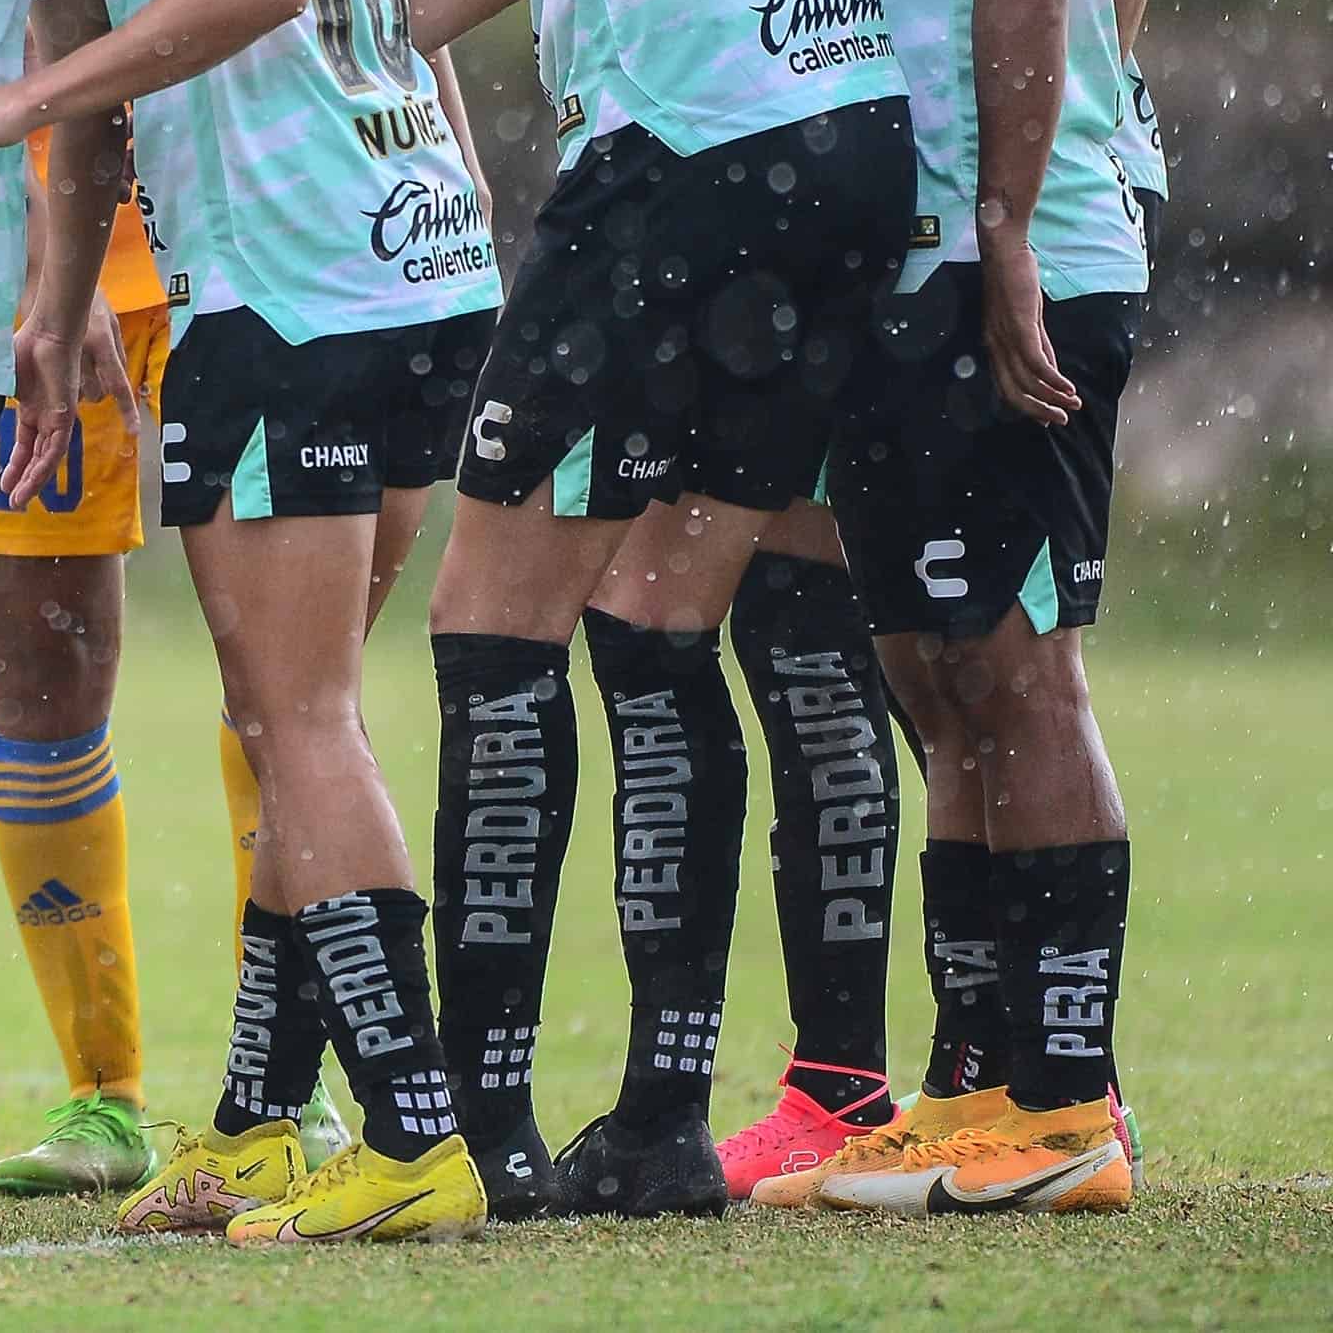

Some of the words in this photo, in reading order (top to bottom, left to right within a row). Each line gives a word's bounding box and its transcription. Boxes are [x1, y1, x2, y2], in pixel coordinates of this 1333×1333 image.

[299, 442, 369, 469] CHARLY
[460, 689, 547, 945] PERDURA
[614, 689, 694, 932] PERDURA
[789, 650, 885, 942] PERDURA
